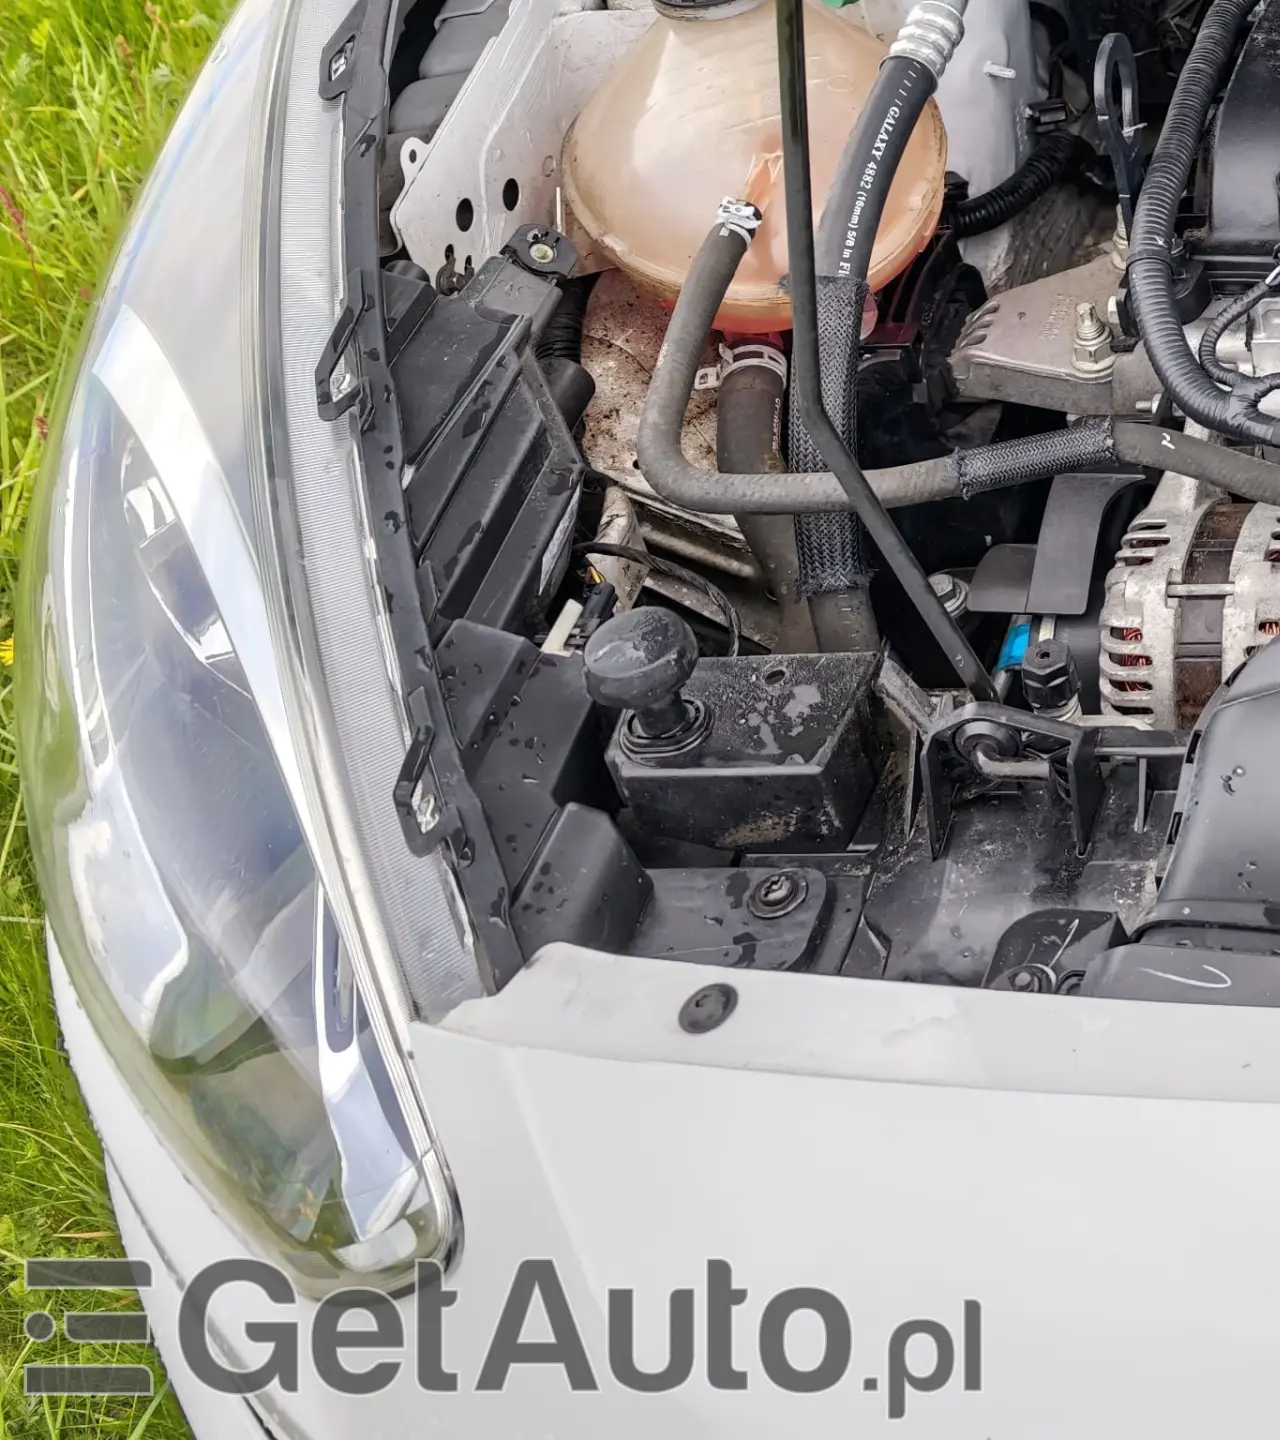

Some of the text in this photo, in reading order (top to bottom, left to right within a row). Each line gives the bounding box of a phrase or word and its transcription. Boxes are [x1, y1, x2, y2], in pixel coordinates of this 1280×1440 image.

[871, 106, 901, 161] GALAXY
[860, 161, 878, 189] 4882
[850, 191, 868, 229] (16mm)
[845, 229, 857, 247] 5/8
